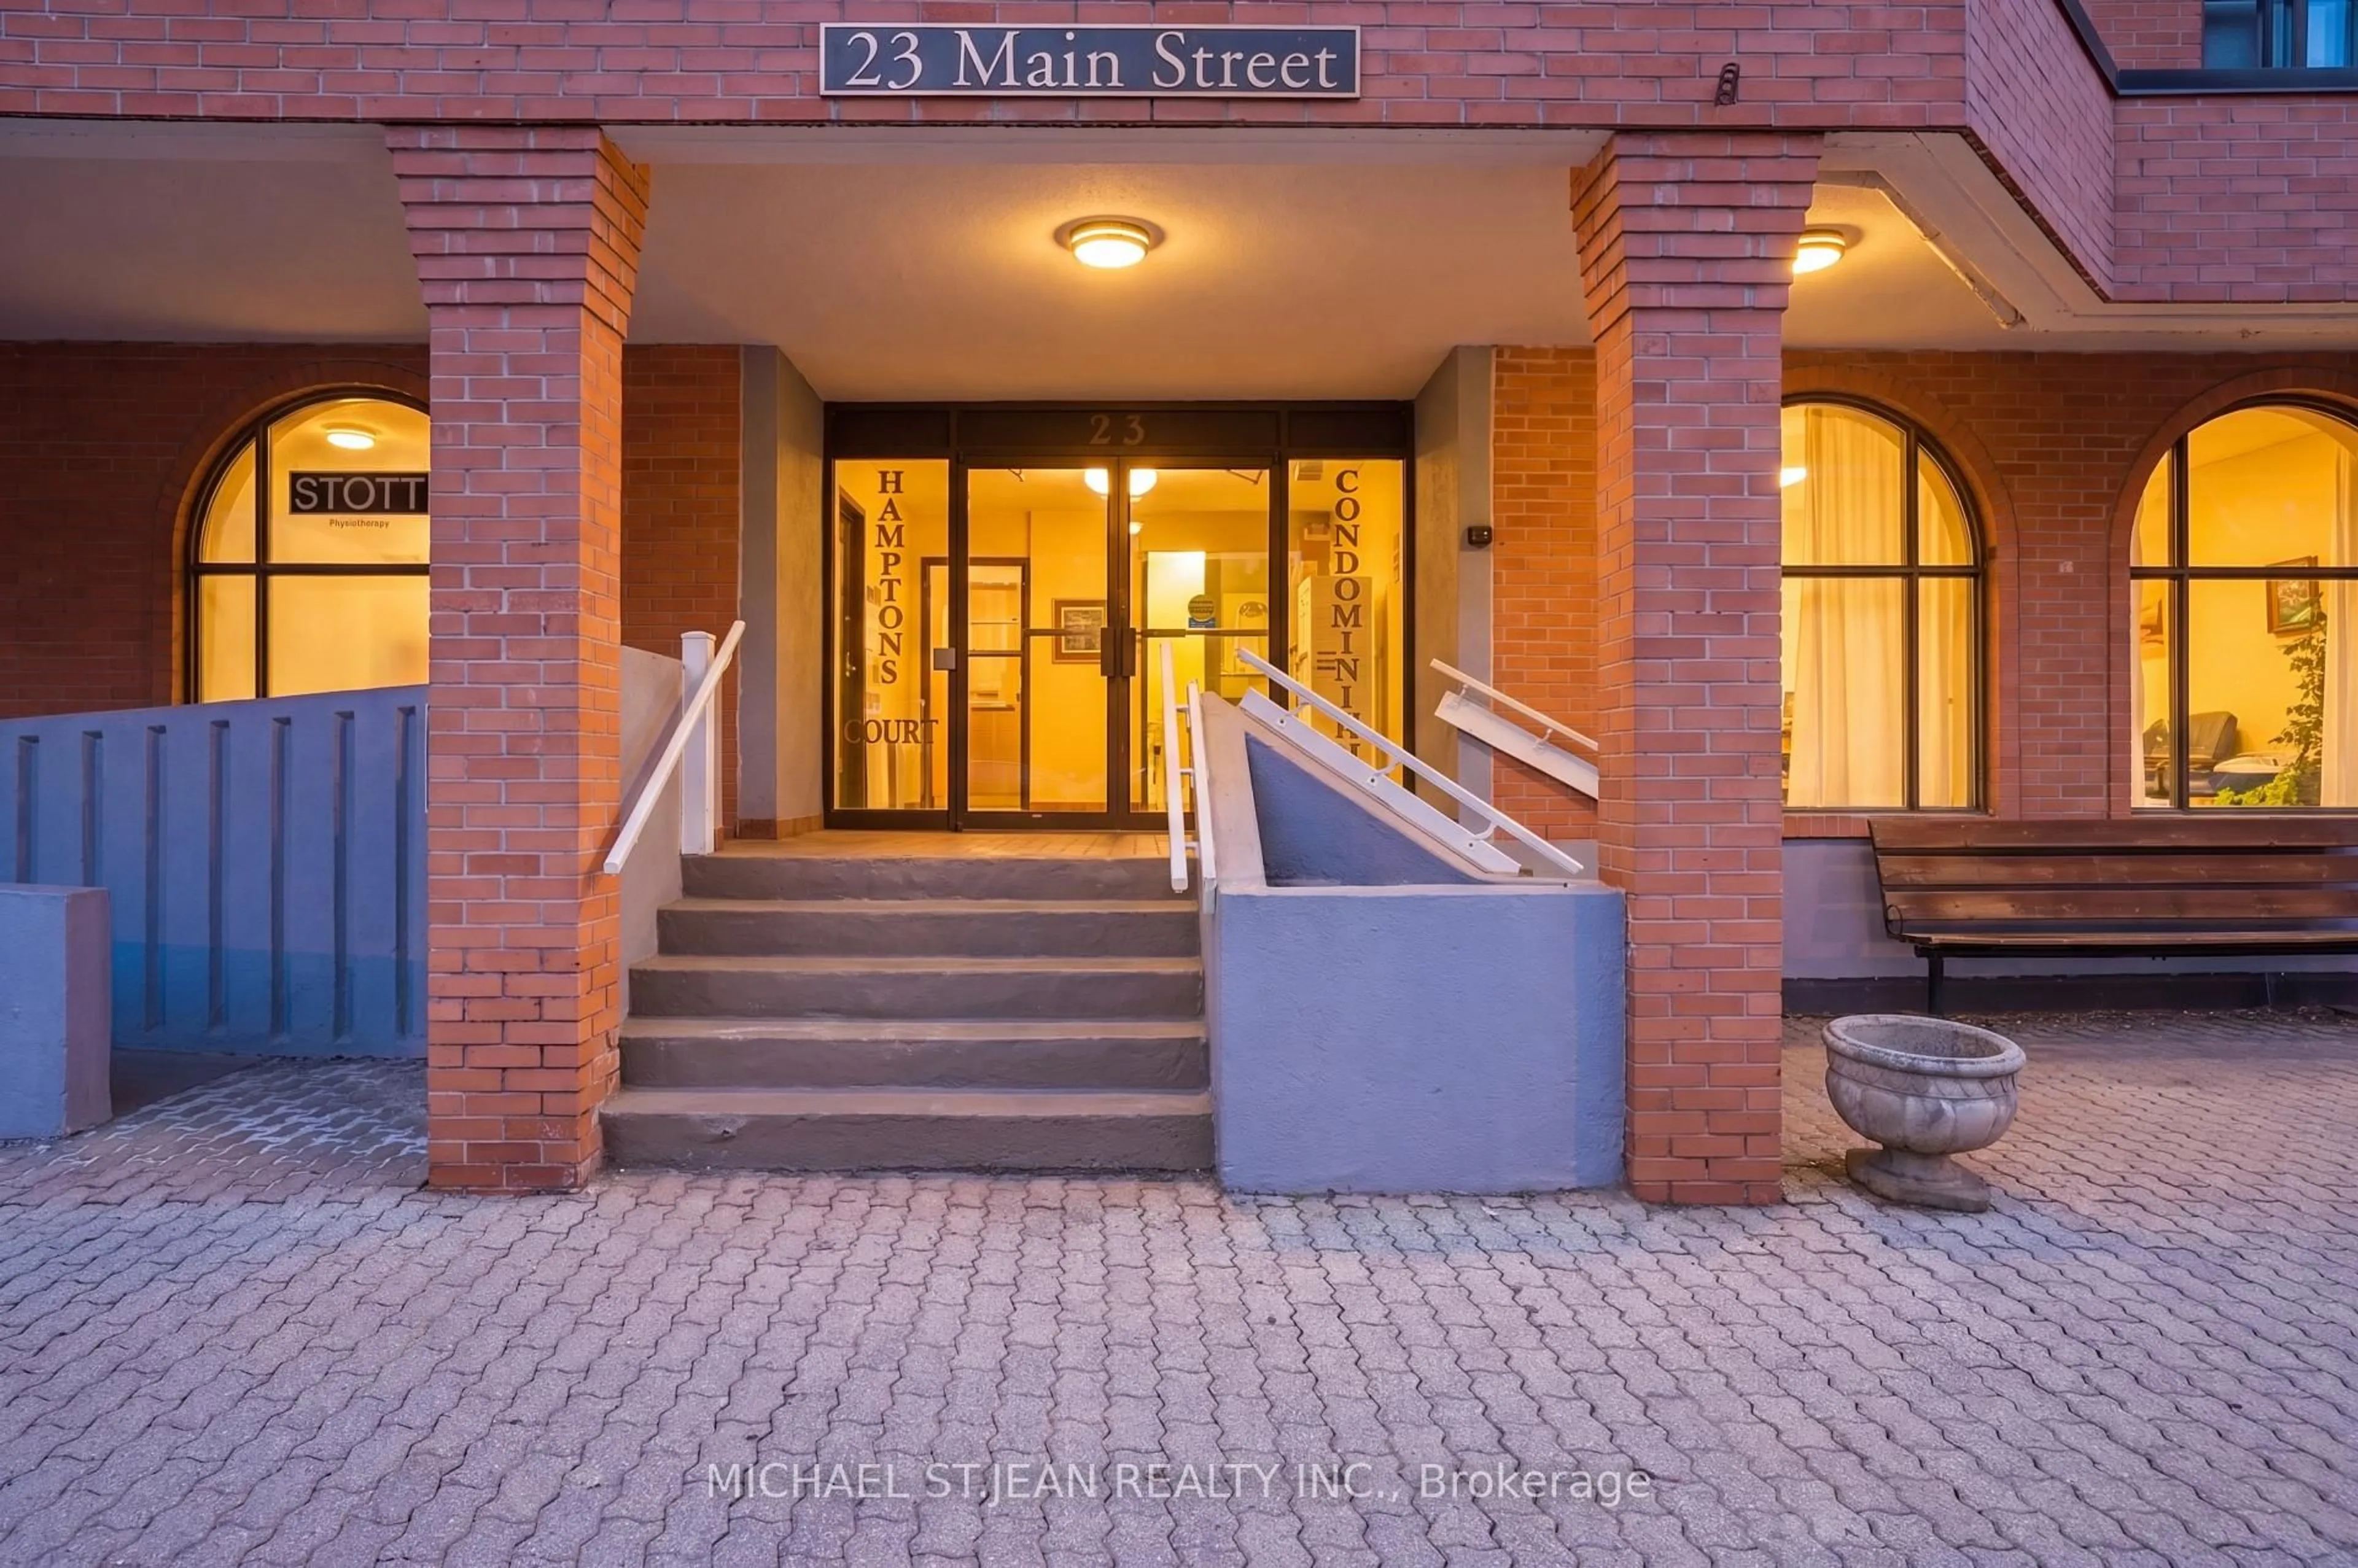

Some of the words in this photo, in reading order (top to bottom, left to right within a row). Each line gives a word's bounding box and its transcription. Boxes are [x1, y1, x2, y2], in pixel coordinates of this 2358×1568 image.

[844, 31, 924, 90] 23
[952, 29, 1124, 88] Main
[1152, 31, 1338, 90] Street
[1089, 414, 1145, 445] 23
[295, 476, 426, 510] STOTT
[329, 519, 390, 529] Physiotherapy
[875, 470, 905, 684] HAMPTONS
[844, 719, 939, 745] COURT
